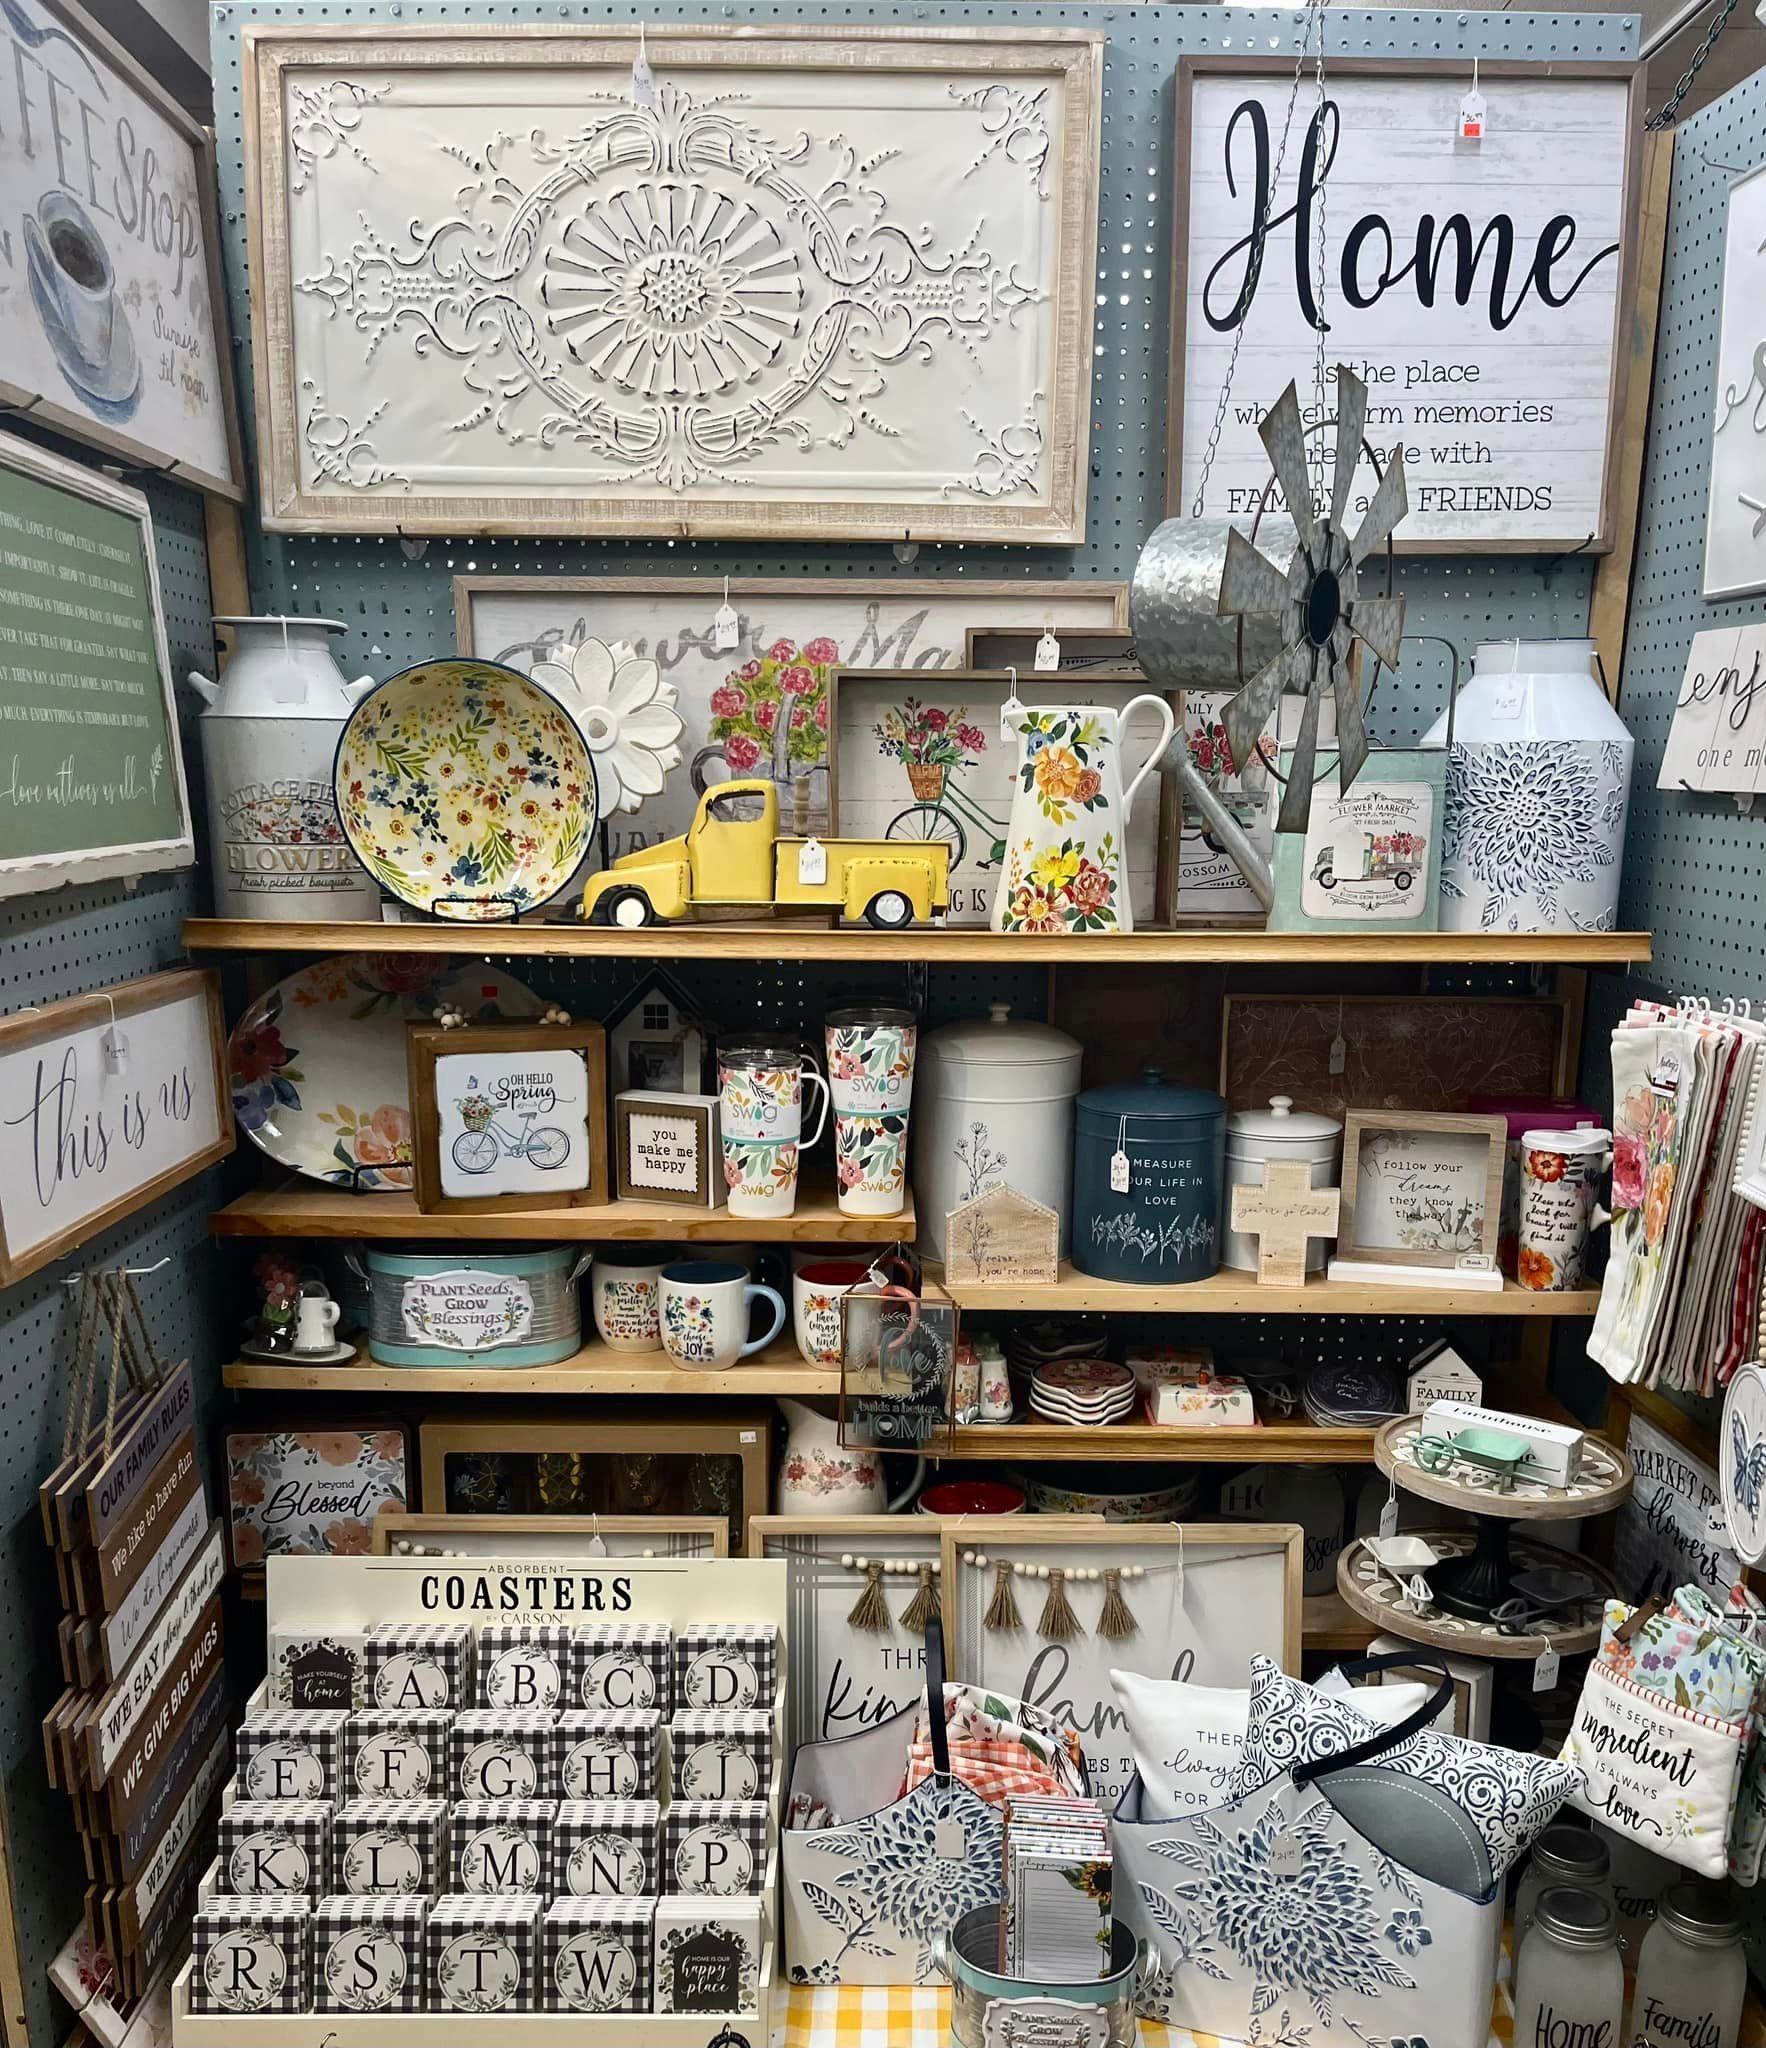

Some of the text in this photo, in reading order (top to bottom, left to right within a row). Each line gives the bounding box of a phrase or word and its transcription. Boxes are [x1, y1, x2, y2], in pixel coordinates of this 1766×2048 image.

[1203, 100, 1619, 332] Home
[1405, 360, 1480, 389] place
[1415, 400, 1553, 423] memories
[1430, 440, 1493, 464] with
[1418, 486, 1553, 511] FRIENDS
[1697, 748, 1733, 768] one
[218, 779, 301, 818] COTTAGE
[1375, 802, 1411, 816] MARKET
[239, 873, 355, 891] fresh picked bouquets
[970, 888, 987, 912] IS
[510, 1072, 554, 1086] OH HELLO
[851, 1074, 901, 1094] swig
[487, 1077, 577, 1114] Spring
[3, 1046, 196, 1208] this is us
[731, 1102, 778, 1123] swig
[637, 1143, 694, 1158] make me
[652, 1129, 678, 1143] you
[644, 1156, 687, 1174] happy
[1133, 1158, 1193, 1170] MEASURE
[1383, 1159, 1464, 1174] follow your
[740, 1182, 775, 1199] swig
[859, 1178, 894, 1195] swig
[1160, 1176, 1203, 1188] LIFE IN
[1145, 1195, 1177, 1207] LOVE
[1389, 1195, 1455, 1208] they know
[421, 1281, 514, 1297] PLANT Seeds,
[444, 1297, 489, 1310] GROW
[682, 1330, 707, 1342] choose
[684, 1341, 705, 1356] JOY
[857, 1399, 939, 1416] builds a better
[1415, 1387, 1478, 1403] FAMILY
[101, 1379, 190, 1518] OUR FAMILY RULES
[317, 1480, 355, 1491] beyond
[1632, 1448, 1698, 1501] MARKET
[111, 1451, 193, 1577] We like to have fun
[261, 1480, 372, 1524] Blessed
[488, 1564, 566, 1574] ABSORBENT
[421, 1575, 633, 1612] COASTERS
[486, 1612, 563, 1625] BY CARSON
[107, 1704, 132, 1746] WE
[133, 1643, 160, 1705] SAY
[297, 1678, 348, 1703] home
[399, 1669, 428, 1709] A
[509, 1664, 538, 1705] B
[603, 1668, 635, 1709] C
[706, 1664, 739, 1705] D
[122, 1621, 218, 1800] WE GIVE BIG HUGS
[1604, 1696, 1675, 1739] THE SECRET
[1581, 1711, 1697, 1787] ingredient
[275, 1757, 301, 1799] E
[378, 1748, 408, 1790] F
[480, 1755, 514, 1798] G
[585, 1754, 618, 1796] H
[707, 1755, 727, 1799] J
[1595, 1760, 1658, 1800] IS ALWAYS
[1174, 1790, 1209, 1806] FOR
[1583, 1784, 1662, 1836] love
[249, 1847, 291, 1890] K
[367, 1846, 399, 1889] L
[482, 1843, 520, 1888] M
[591, 1853, 625, 1896] N
[700, 1841, 729, 1884] P
[227, 1946, 264, 1991] R
[353, 1943, 378, 1991] S
[459, 1949, 499, 1993] T
[570, 1950, 616, 1994] W
[682, 1955, 731, 1981] happy
[681, 1977, 729, 1999] place
[1010, 2009, 1047, 2022] PLANT
[1535, 2003, 1614, 2048] Home
[1643, 1996, 1721, 2048] Family
[1028, 2025, 1064, 2036] GROW
